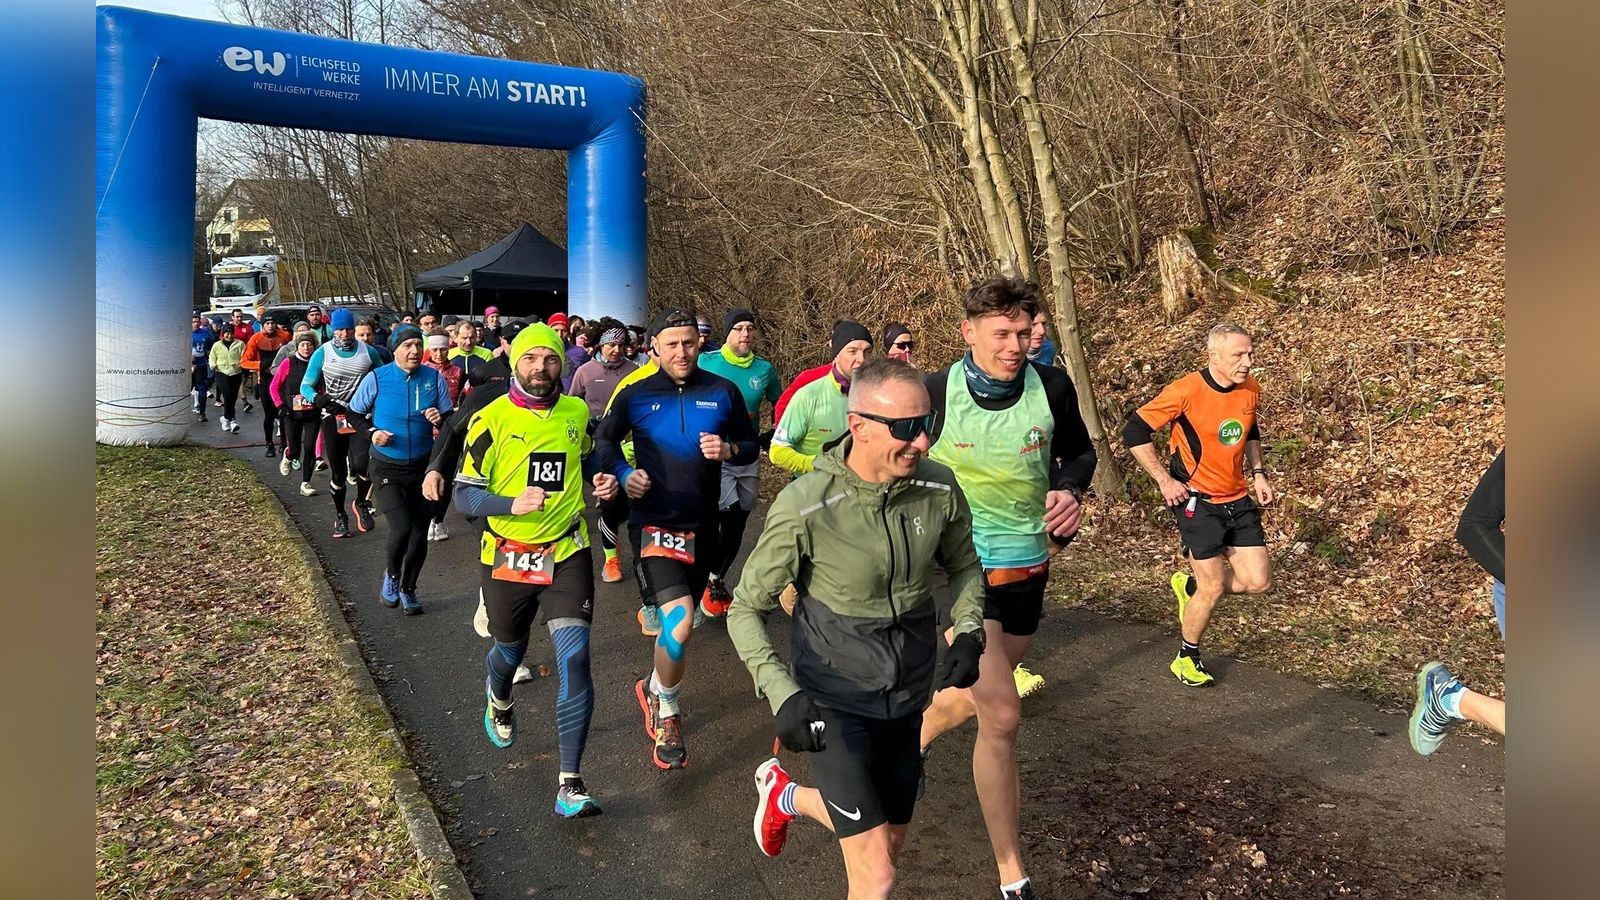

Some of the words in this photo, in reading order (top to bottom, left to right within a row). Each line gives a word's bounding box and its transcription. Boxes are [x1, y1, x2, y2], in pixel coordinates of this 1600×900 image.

[301, 56, 361, 72] EICHSFELD
[322, 71, 361, 86] WERKE
[385, 66, 460, 97] IMMER
[466, 76, 499, 100] AM
[506, 80, 587, 108] START!
[253, 81, 312, 95] INTELLIGENT
[1221, 428, 1241, 437] EAM
[532, 461, 563, 482] 1&1
[651, 530, 687, 552] 132
[505, 550, 545, 572] 143
